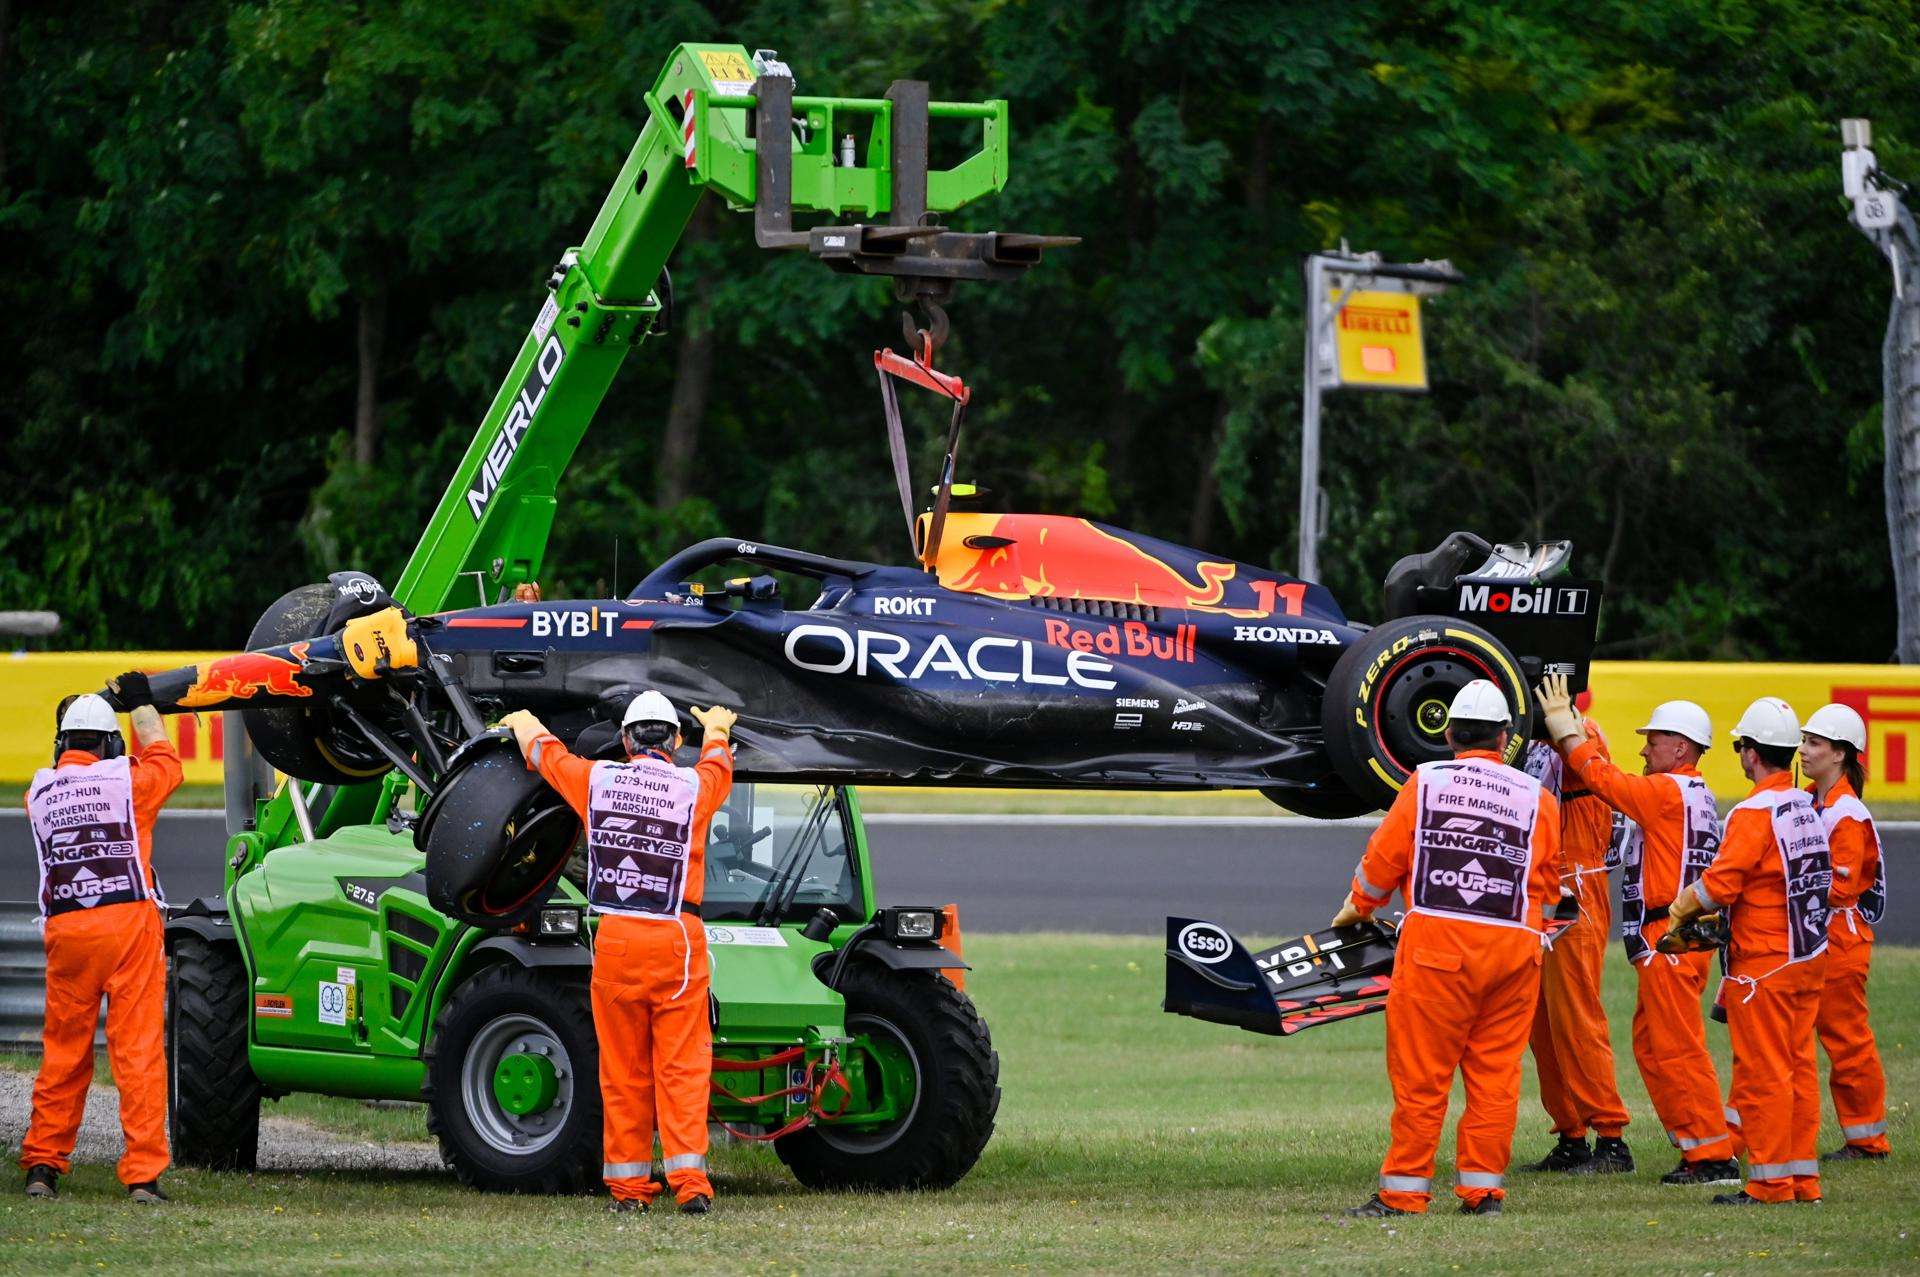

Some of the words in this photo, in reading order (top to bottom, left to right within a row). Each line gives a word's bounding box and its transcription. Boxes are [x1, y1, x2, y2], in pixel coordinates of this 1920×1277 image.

[1340, 305, 1411, 334] PIRELLI
[467, 335, 564, 520] MERLO
[874, 597, 937, 615] ROKT
[1249, 580, 1308, 616] 11
[1458, 585, 1552, 614] Mobil
[1566, 590, 1578, 611] 1
[532, 606, 618, 637] BYBIT
[1045, 619, 1120, 656] Red
[1123, 621, 1197, 663] Bull
[1234, 626, 1341, 645] HONDA
[784, 624, 1118, 690] ORACLE
[1358, 635, 1409, 704] ZERO
[1116, 698, 1160, 709] SIEMENS
[1355, 707, 1368, 729] P
[46, 786, 101, 806] 0277-HUN
[614, 775, 670, 793] 0279-HUN
[601, 790, 675, 810] INTERVENTION
[612, 801, 661, 817] MARSHAL
[1438, 793, 1465, 806] FIRE
[1468, 797, 1520, 822] MARSHAL
[43, 802, 111, 826] INTERVENTION
[51, 813, 100, 829] MARSHAL
[346, 882, 376, 904] P27.6
[1429, 869, 1515, 897] COURSE
[1256, 934, 1345, 984] YBIT
